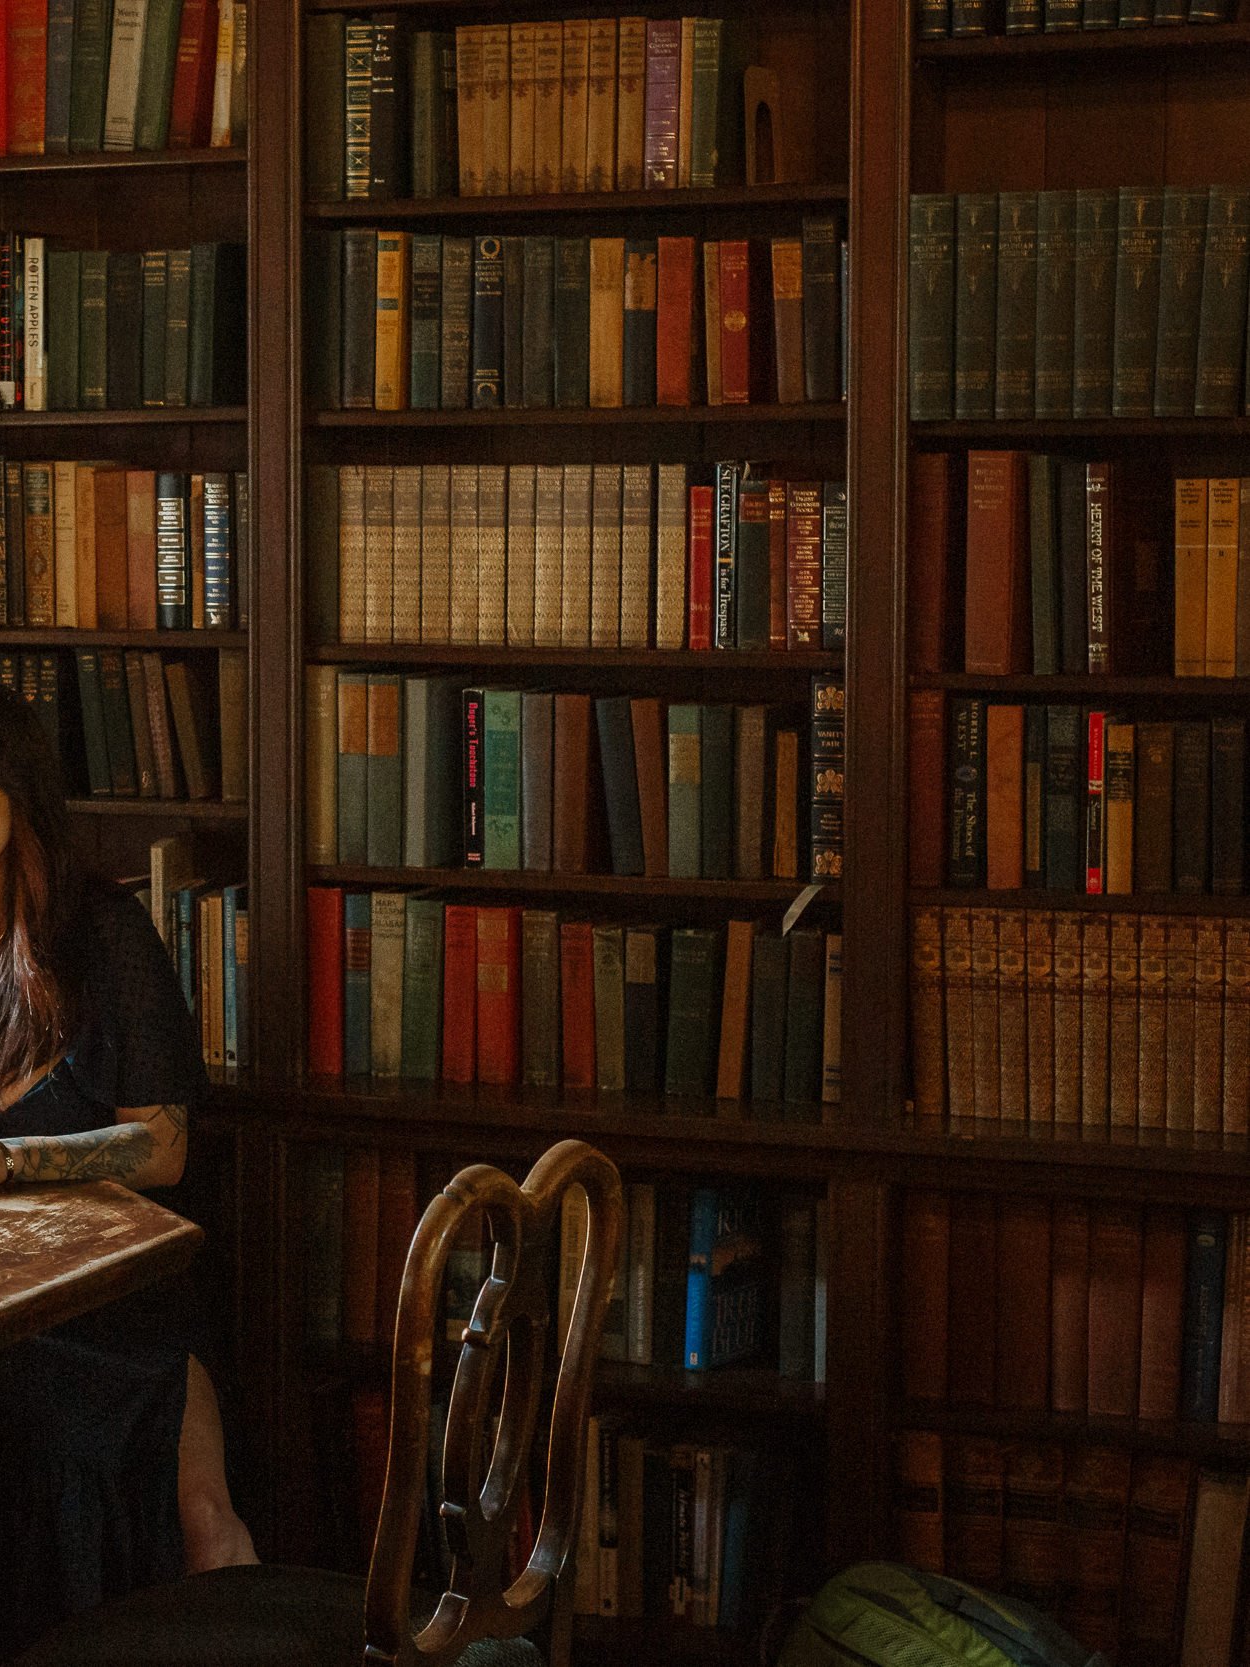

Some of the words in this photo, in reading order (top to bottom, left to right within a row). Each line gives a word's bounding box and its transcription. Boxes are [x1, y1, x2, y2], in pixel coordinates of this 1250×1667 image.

[28, 257, 39, 301] ROTTEN
[28, 304, 39, 348] APPLES
[720, 469, 731, 493] SUE
[720, 494, 731, 552] GRAFTON
[1090, 502, 1102, 545] HEART
[1091, 548, 1102, 565] OF
[720, 577, 731, 590] for
[1092, 566, 1103, 593] THE
[719, 591, 732, 637] Trespass
[1092, 594, 1103, 633] WEST
[817, 730, 843, 738] VANITY
[957, 710, 967, 750] WEST
[970, 702, 979, 746] MORRIS
[468, 739, 479, 788] Touchstone
[965, 792, 976, 811] The
[953, 808, 963, 860] Fisherman
[966, 815, 976, 843] Shoes
